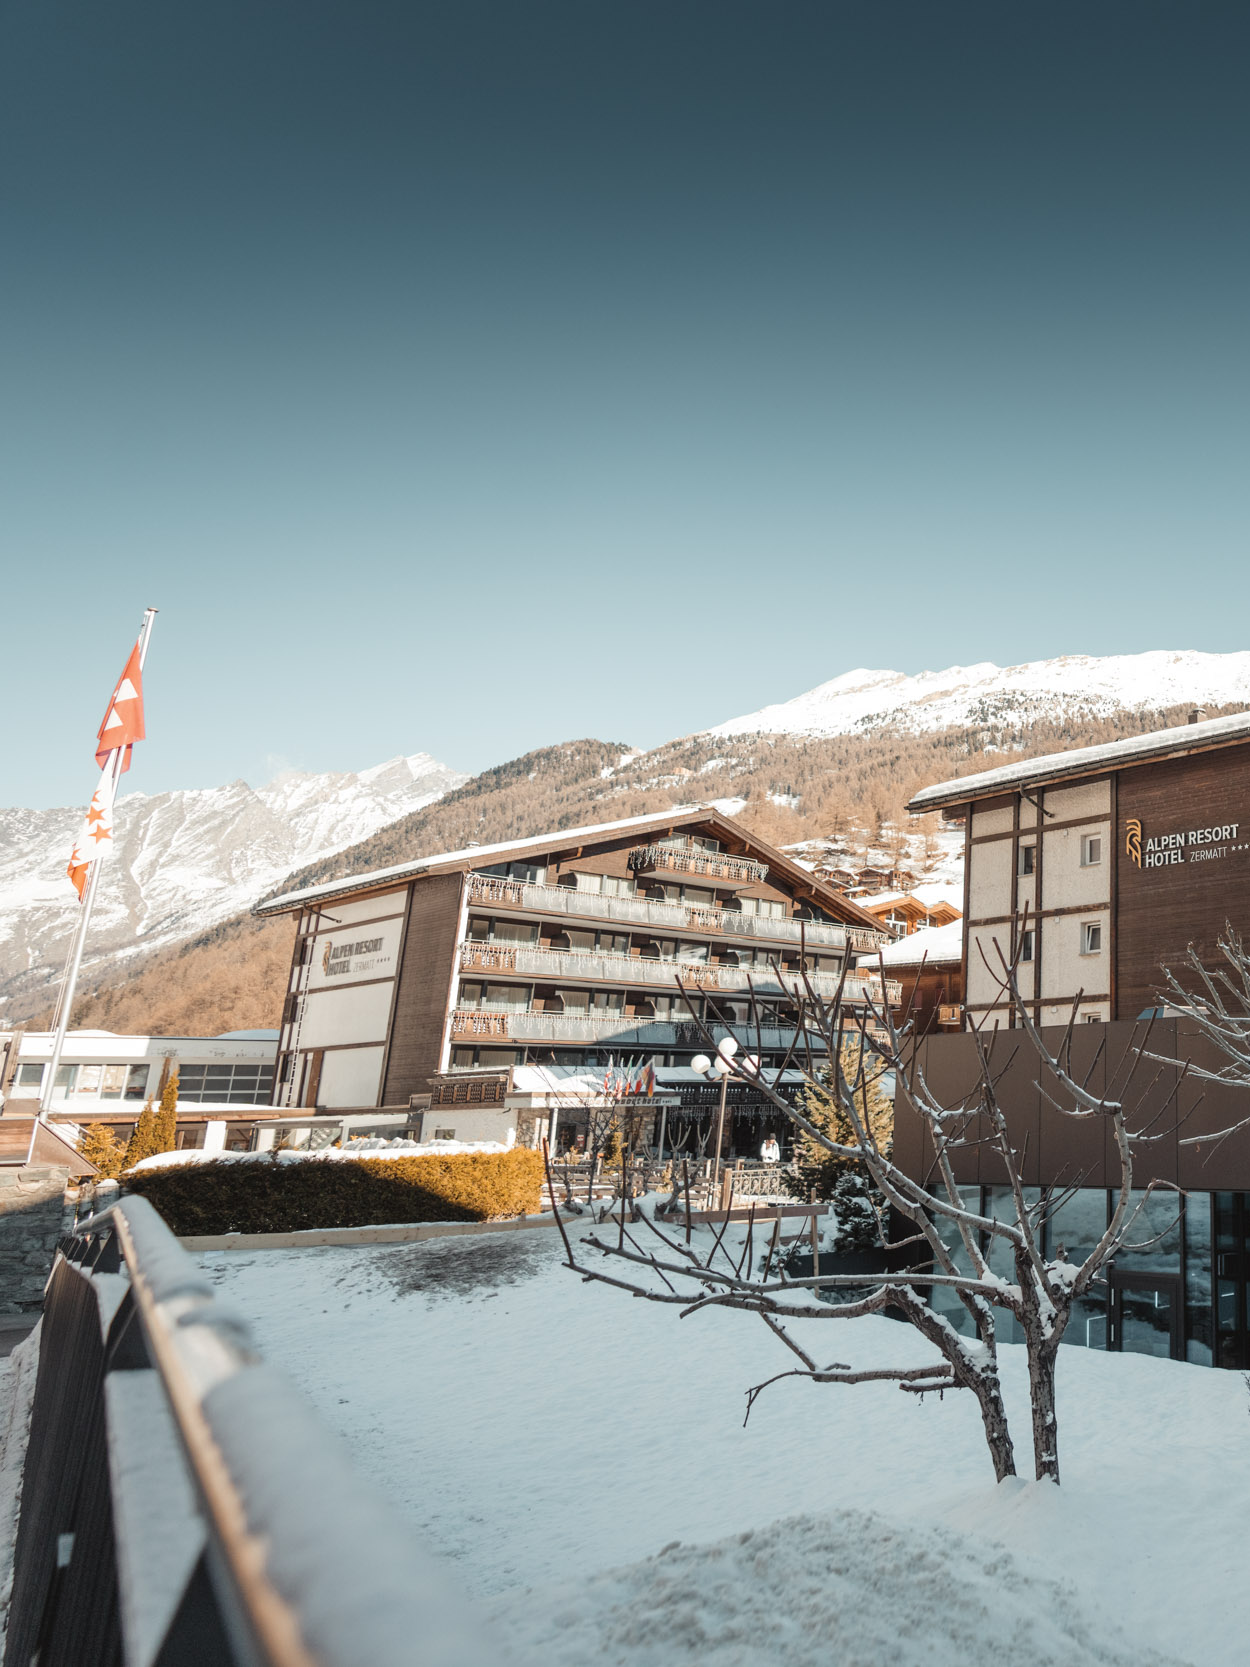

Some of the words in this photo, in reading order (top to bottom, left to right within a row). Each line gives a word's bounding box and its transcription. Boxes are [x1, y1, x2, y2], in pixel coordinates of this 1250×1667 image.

[1146, 833, 1186, 852] ALPEN
[1188, 824, 1239, 845] RESORT
[1145, 849, 1185, 868] HOTEL
[1190, 846, 1227, 862] ZERMATT
[331, 943, 355, 960] ALPEN
[354, 937, 384, 955] RESORT
[329, 959, 351, 976] HOTEL
